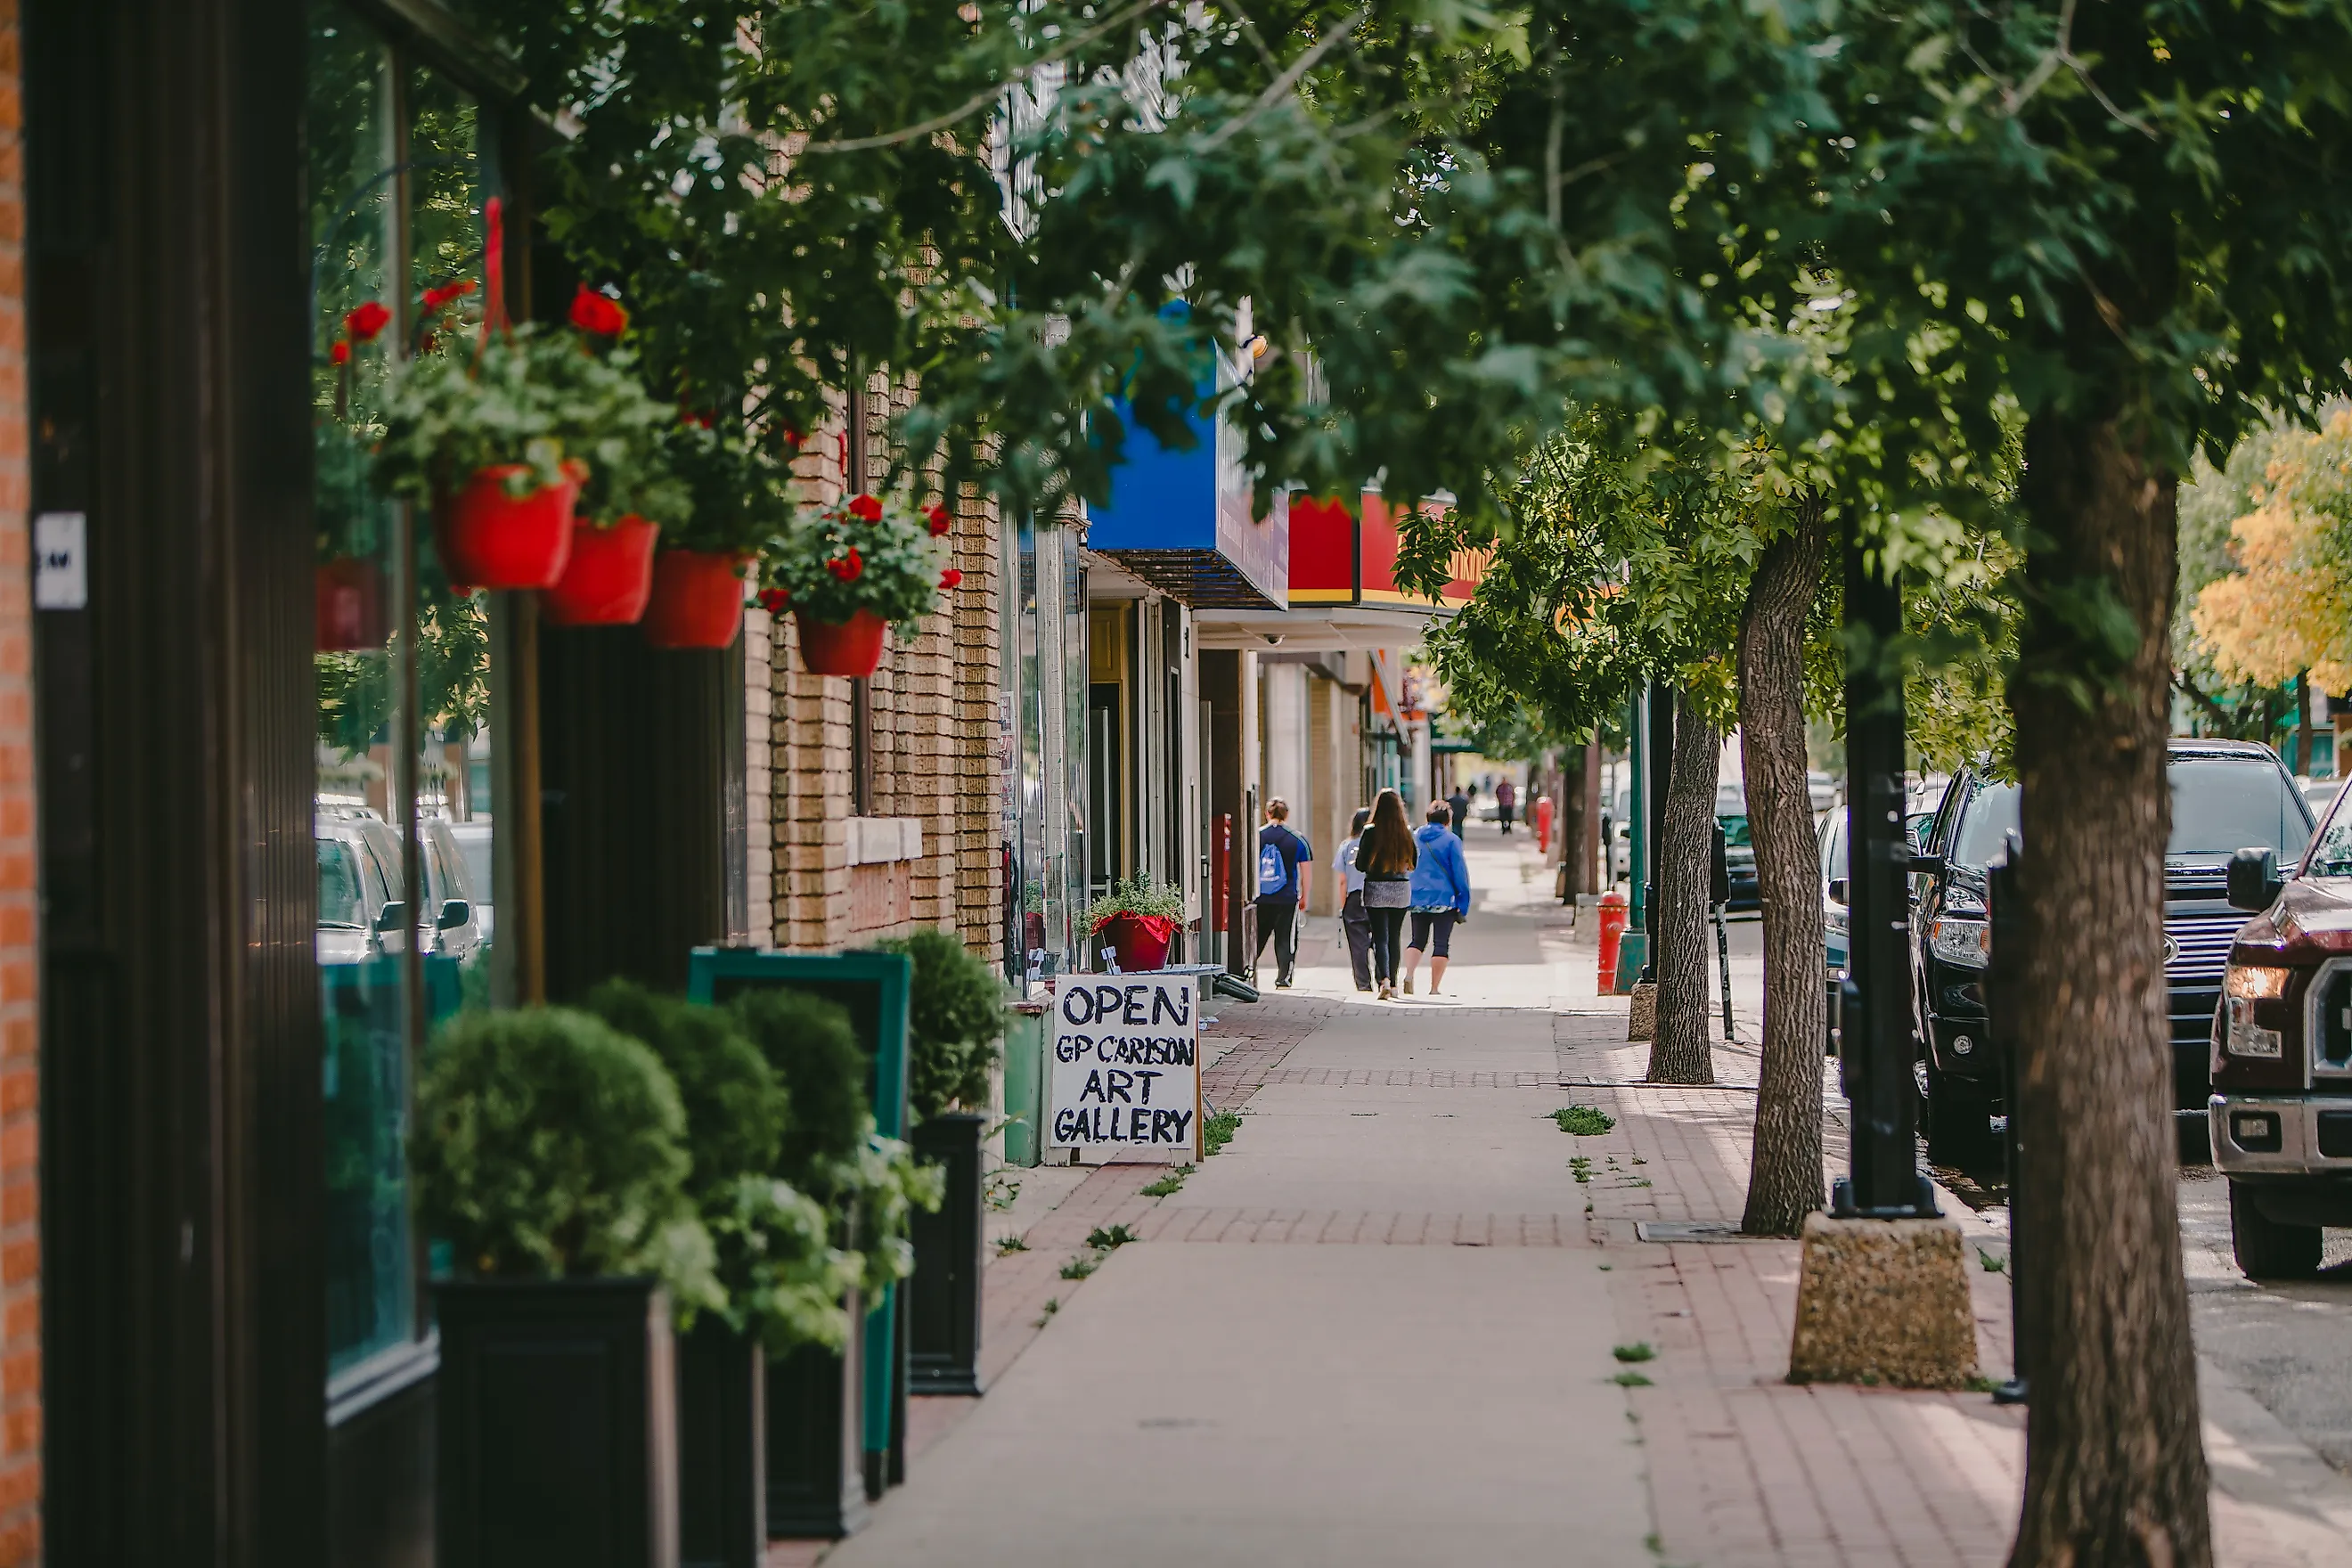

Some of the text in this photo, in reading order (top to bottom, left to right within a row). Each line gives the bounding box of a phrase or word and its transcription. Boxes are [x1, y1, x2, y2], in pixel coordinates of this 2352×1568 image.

[1062, 984, 1189, 1026] OPEN
[1056, 1034, 1195, 1066] GP CARLSON
[1079, 1068, 1164, 1106] ART
[1054, 1107, 1193, 1144] GALLERY
